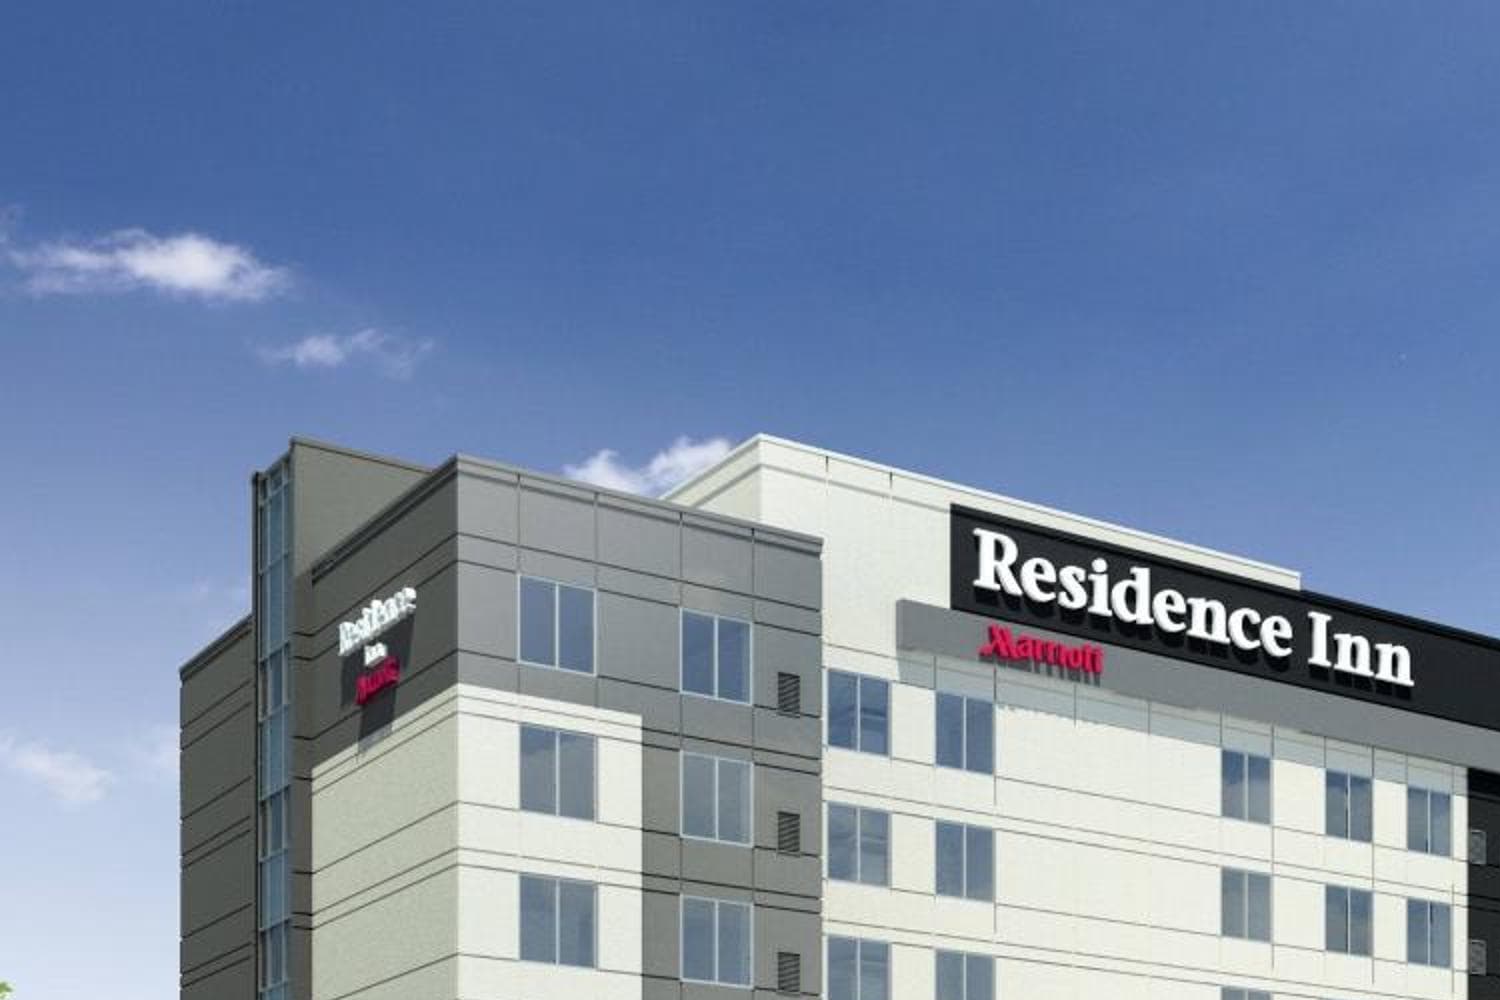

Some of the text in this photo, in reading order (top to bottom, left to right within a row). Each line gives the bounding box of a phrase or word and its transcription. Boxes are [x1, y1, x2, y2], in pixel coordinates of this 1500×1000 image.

[972, 527, 1415, 687] Residence Inn
[977, 624, 1104, 673] Marriott
